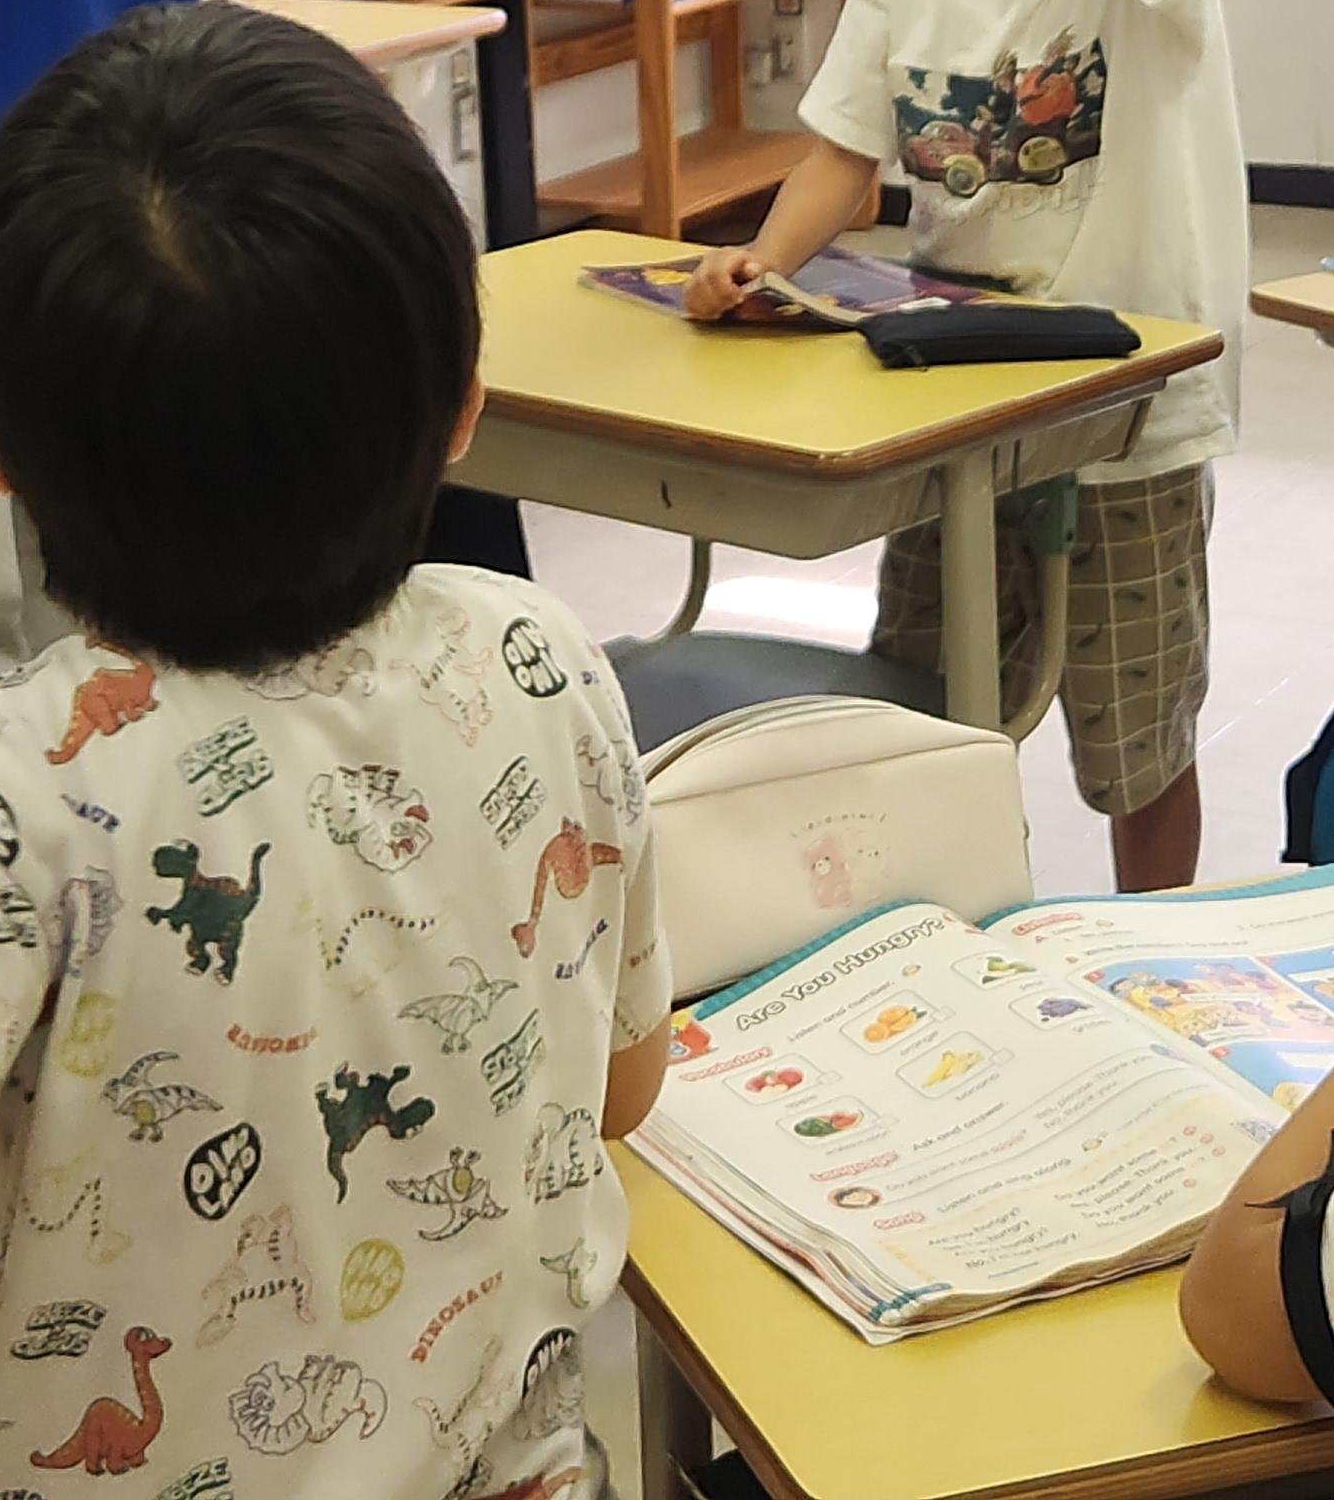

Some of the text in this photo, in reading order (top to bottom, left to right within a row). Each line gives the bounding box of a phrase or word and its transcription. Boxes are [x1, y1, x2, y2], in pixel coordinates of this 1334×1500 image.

[736, 917, 945, 1032] Are You Hungry?
